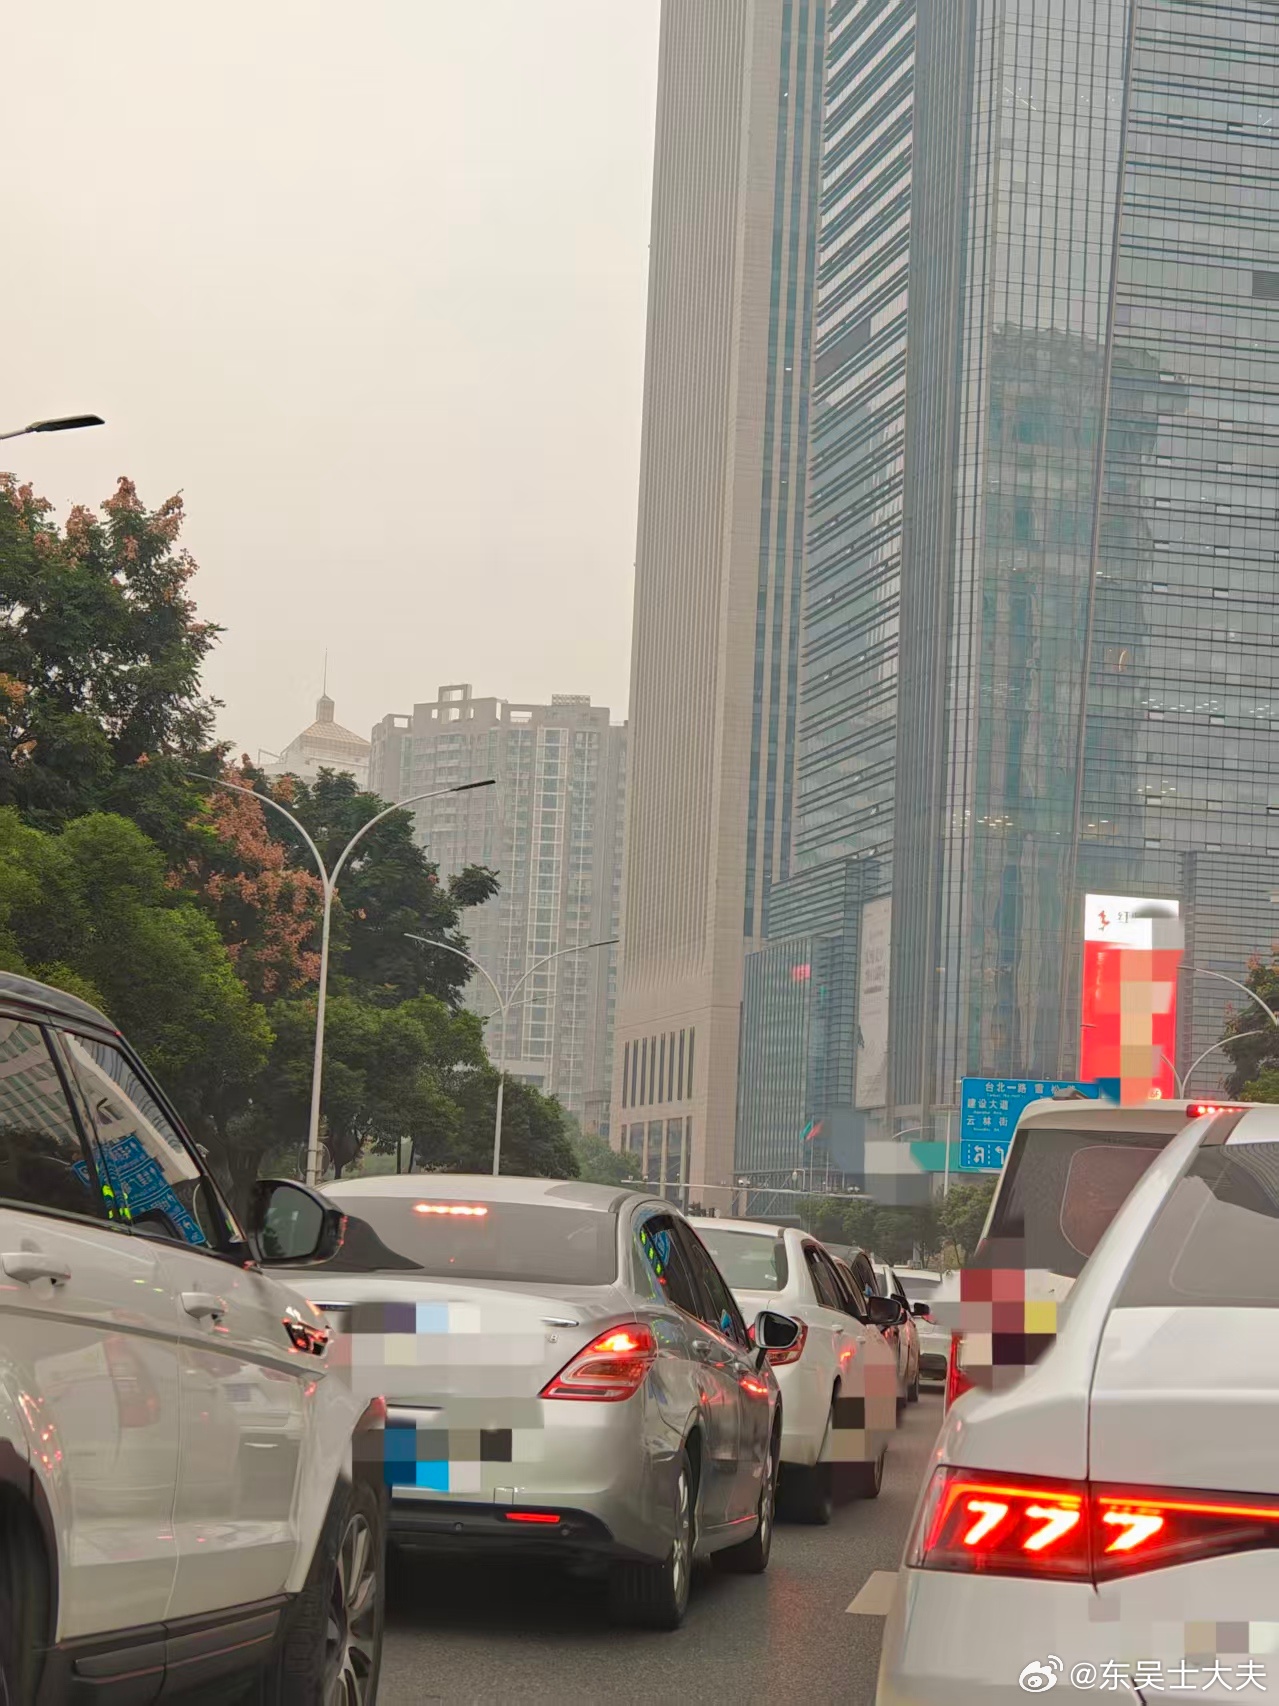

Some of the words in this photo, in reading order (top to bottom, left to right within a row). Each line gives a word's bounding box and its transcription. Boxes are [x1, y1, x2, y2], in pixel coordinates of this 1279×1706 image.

[985, 1082, 1027, 1093] 台北一路
[967, 1098, 1009, 1110] 建设大道
[966, 1115, 1008, 1127] 云林街
